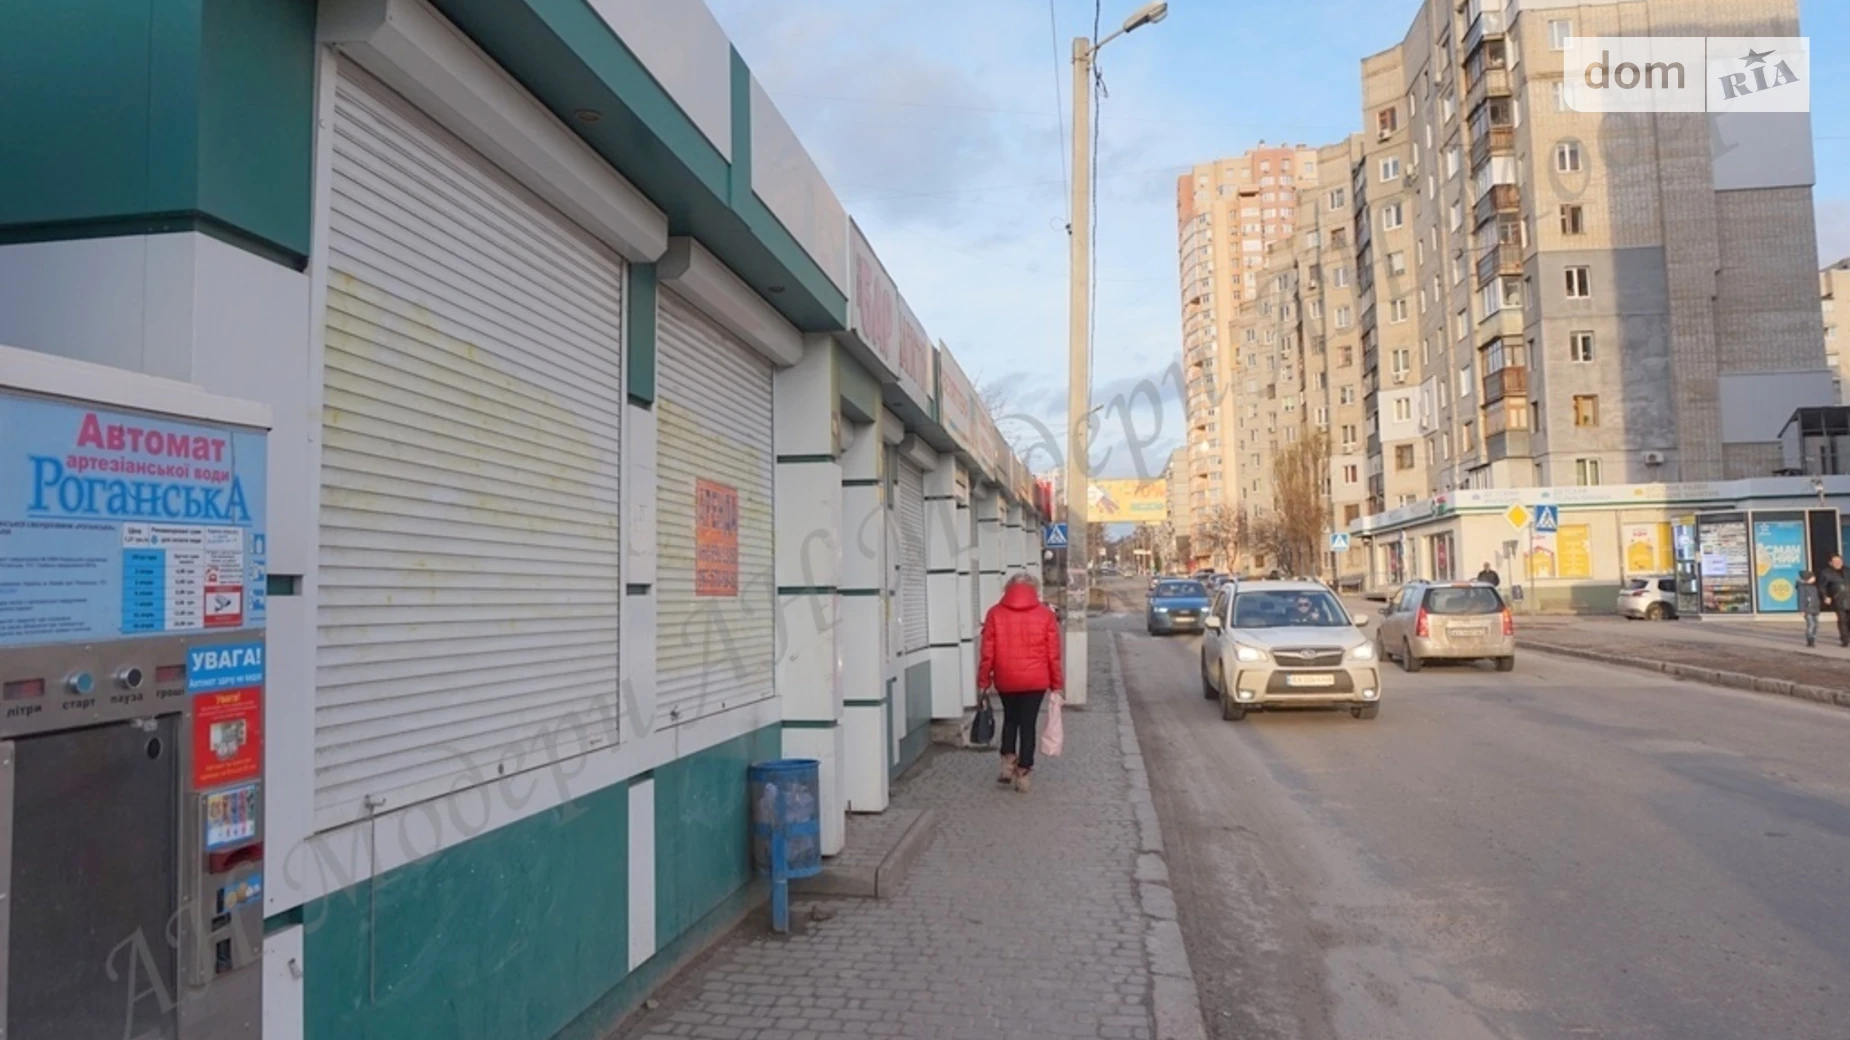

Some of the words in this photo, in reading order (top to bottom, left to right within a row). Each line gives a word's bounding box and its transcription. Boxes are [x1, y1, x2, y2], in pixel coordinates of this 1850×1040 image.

[77, 413, 226, 462] Автомат
[66, 453, 190, 478] артезіанської
[194, 466, 229, 484] води
[192, 648, 262, 672] УВАГА!
[7, 703, 43, 718] літри
[62, 699, 96, 711] старт
[110, 693, 144, 706] пауза
